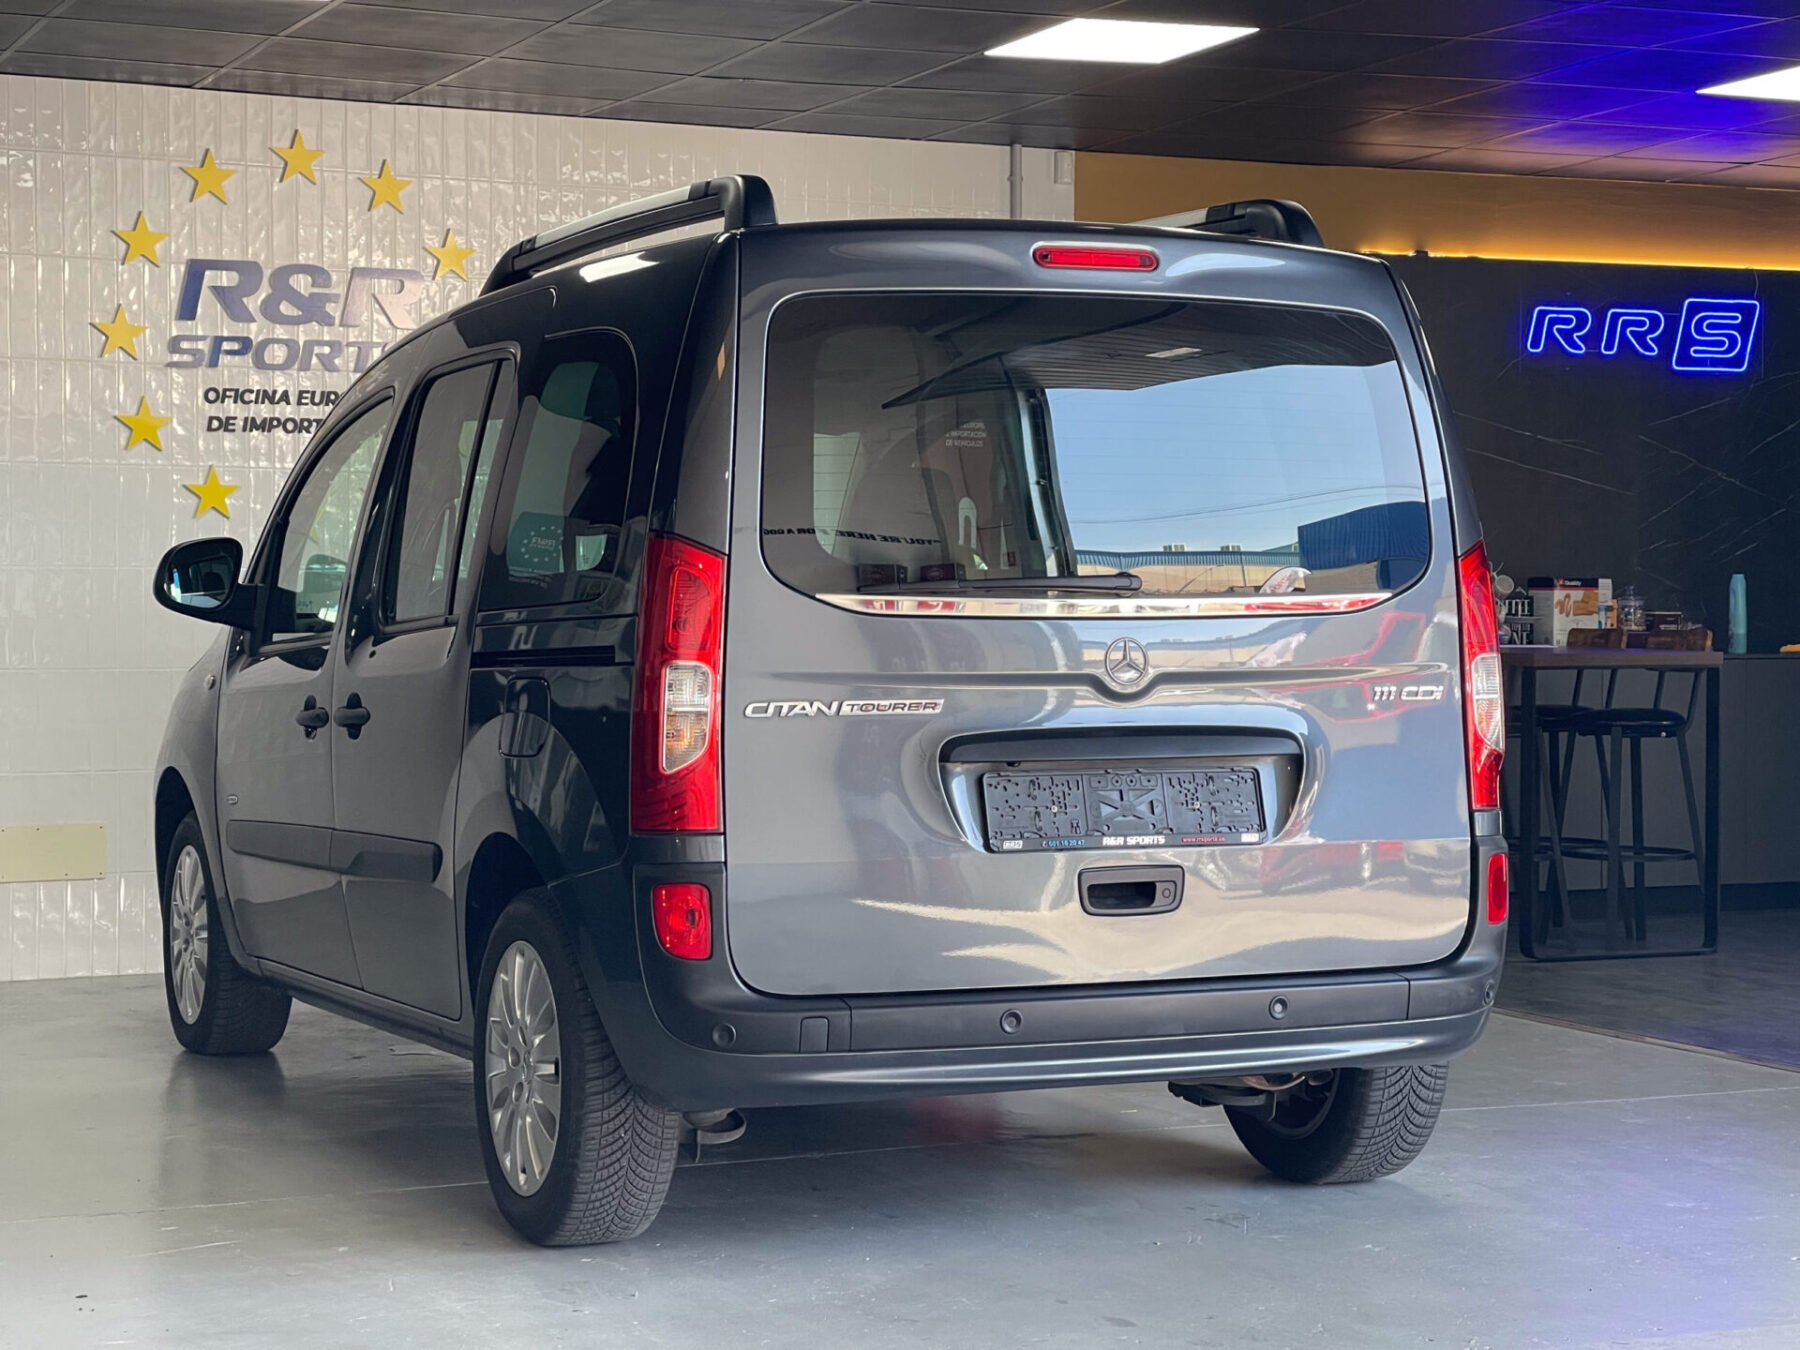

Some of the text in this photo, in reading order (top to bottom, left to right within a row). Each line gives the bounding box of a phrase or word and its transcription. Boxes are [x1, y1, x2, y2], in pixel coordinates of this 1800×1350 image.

[175, 258, 425, 331] R&R
[164, 335, 389, 373] SPORT
[203, 387, 346, 407] OFICINA EUR
[206, 416, 238, 433] DE
[1373, 685, 1444, 701] 111 CDI
[744, 700, 939, 718] CITAN TOURER
[1102, 835, 1166, 846] R&R SPORTS
